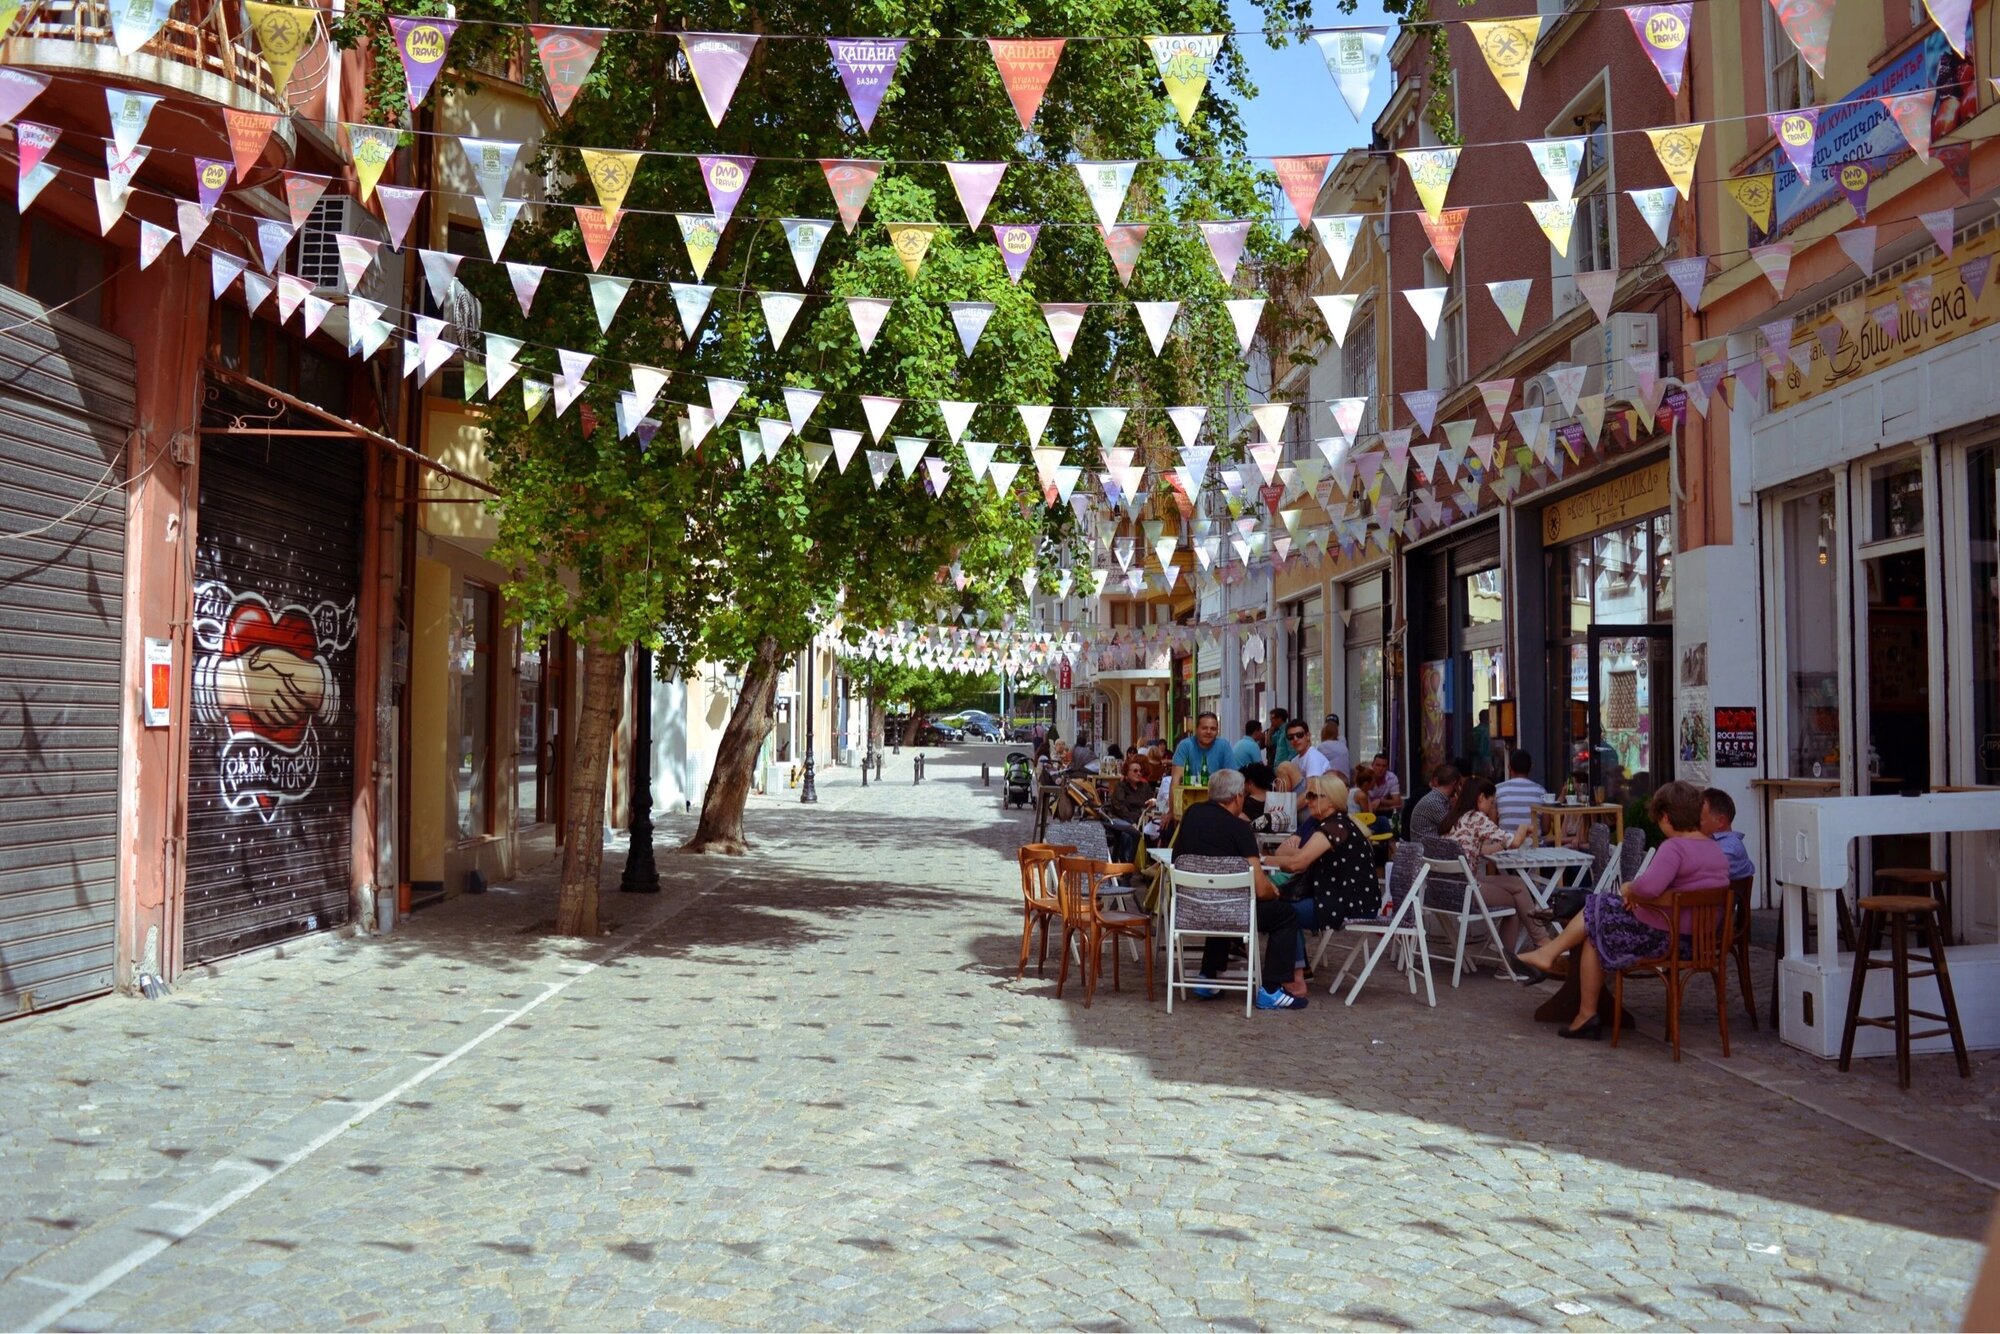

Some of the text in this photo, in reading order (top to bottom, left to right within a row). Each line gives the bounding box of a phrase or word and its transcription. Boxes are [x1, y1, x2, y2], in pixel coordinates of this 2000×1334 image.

[1651, 18, 1677, 33] DND
[412, 30, 438, 46] DND
[1653, 30, 1680, 43] TRAVEL
[412, 47, 439, 58] TRAVEL
[838, 45, 897, 64] КАПАНА
[998, 45, 1058, 62] КАПАНА
[1155, 36, 1222, 64] BOOM
[1166, 53, 1211, 78] ART
[856, 77, 878, 86] БАЗАР
[1778, 53, 1924, 169] АРКИ КУЛТУРЕН ЦЕНТЪР
[230, 116, 272, 130] КАПАНА
[1784, 120, 1806, 133] DND
[350, 126, 398, 149] BOOM
[1787, 132, 1809, 140] TRAVEL
[1278, 160, 1325, 172] КАПАНА
[1412, 150, 1458, 173] BOOM
[206, 166, 224, 178] DND
[716, 164, 738, 179] DND
[1844, 168, 1862, 180] DND
[715, 178, 738, 188] TRAVEL
[580, 211, 618, 223] КАПА
[1424, 213, 1464, 224] КПАНА
[1008, 232, 1026, 242] DND
[318, 609, 334, 636] 15
[1716, 732, 1736, 740] ROCK
[226, 747, 270, 792] PARK
